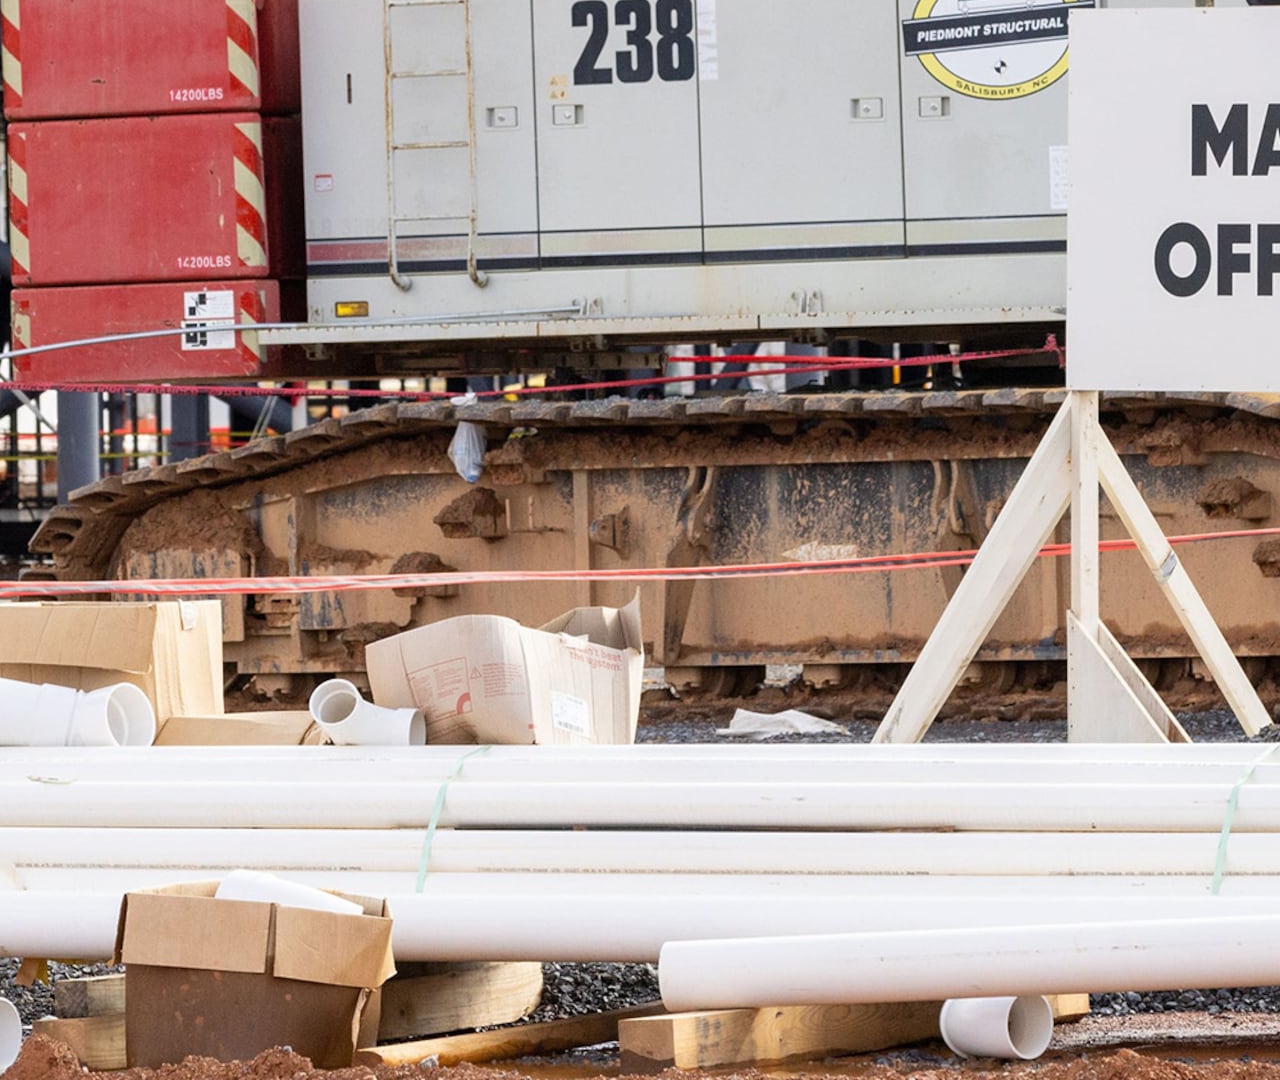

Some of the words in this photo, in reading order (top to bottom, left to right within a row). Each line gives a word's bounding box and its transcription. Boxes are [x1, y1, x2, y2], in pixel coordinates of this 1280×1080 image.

[917, 25, 981, 43] PIEDMONT
[982, 17, 1065, 36] STRUCTURAL
[1032, 76, 1049, 89] NC
[169, 87, 224, 101] 14200LBS
